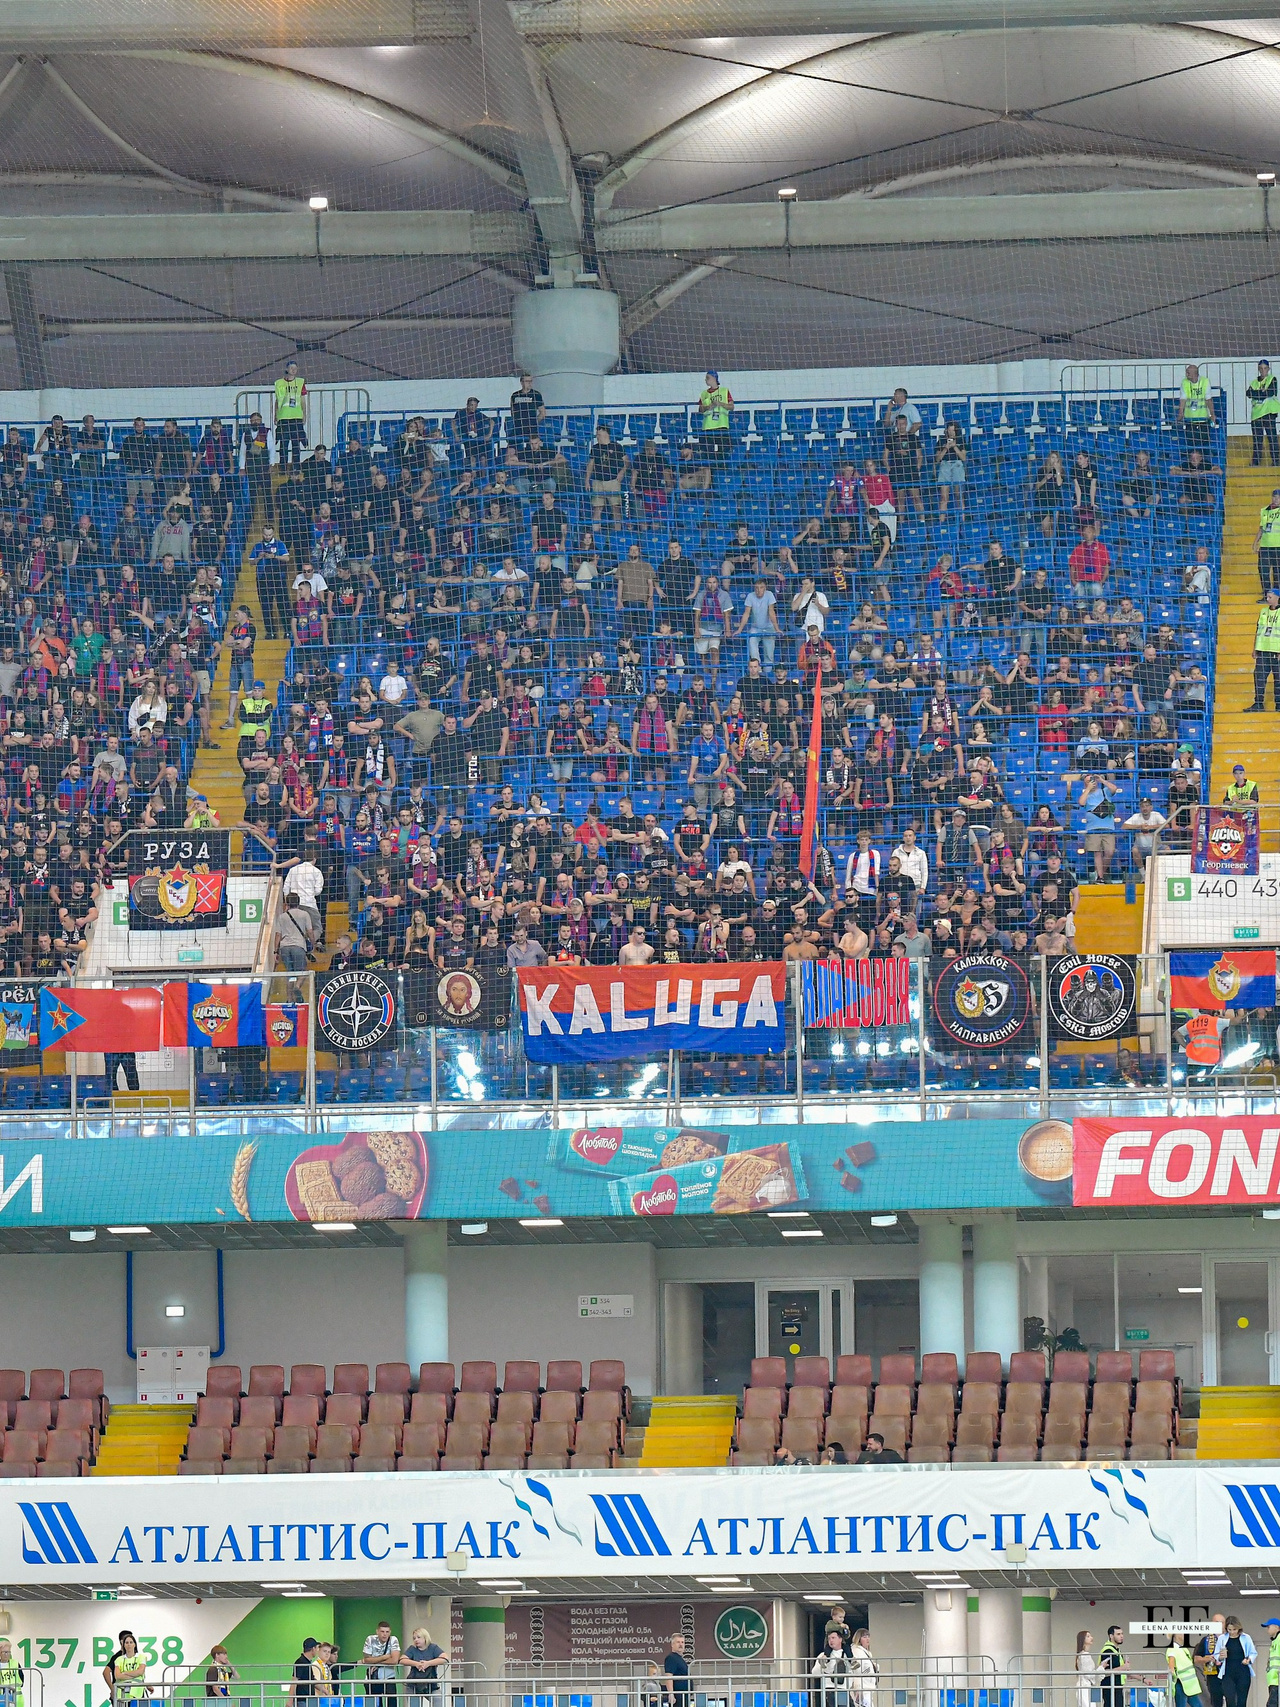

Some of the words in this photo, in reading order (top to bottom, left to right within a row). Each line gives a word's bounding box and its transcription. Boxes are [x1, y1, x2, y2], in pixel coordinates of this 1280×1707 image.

[1211, 828, 1242, 842] ЦСКА
[143, 842, 210, 861] РУЗА
[1201, 860, 1249, 870] Георгиевск
[1198, 879, 1238, 898] 440
[1252, 879, 1280, 898] 43
[952, 955, 1009, 973] КАЛУЖСКОЕ
[1059, 955, 1082, 974] Evil
[1085, 954, 1121, 969] Horse
[327, 973, 384, 993] ОБНИНСКИЕ
[802, 957, 910, 1028] КЛАДОВАЯ
[195, 1007, 230, 1019] ЦСКА
[523, 975, 779, 1036] KALUGA
[273, 1021, 292, 1031] ЦСКА
[949, 1018, 1020, 1043] НАПРАВЛЕНИЕ
[1192, 1018, 1209, 1028] 1119
[328, 1029, 347, 1046] ЦСКА
[351, 1028, 383, 1047] МОСКВА
[578, 1134, 618, 1155] Любятово
[1092, 1129, 1280, 1198] FON
[640, 1188, 677, 1214] Любятово
[108, 1520, 521, 1564] АТЛАНТИС-ПАК
[682, 1512, 1101, 1556] АТЛАНТИС-ПАК
[570, 1608, 594, 1616] ВОДА
[609, 1607, 628, 1615] ГАЗА
[571, 1626, 616, 1635] ХОЛОДНЫЙ
[617, 1626, 634, 1634] ЧАЙ
[571, 1636, 613, 1645] ТУРЕЦКИЙ
[613, 1637, 655, 1645] ЛИМОНАД
[92, 1636, 184, 1667] B38
